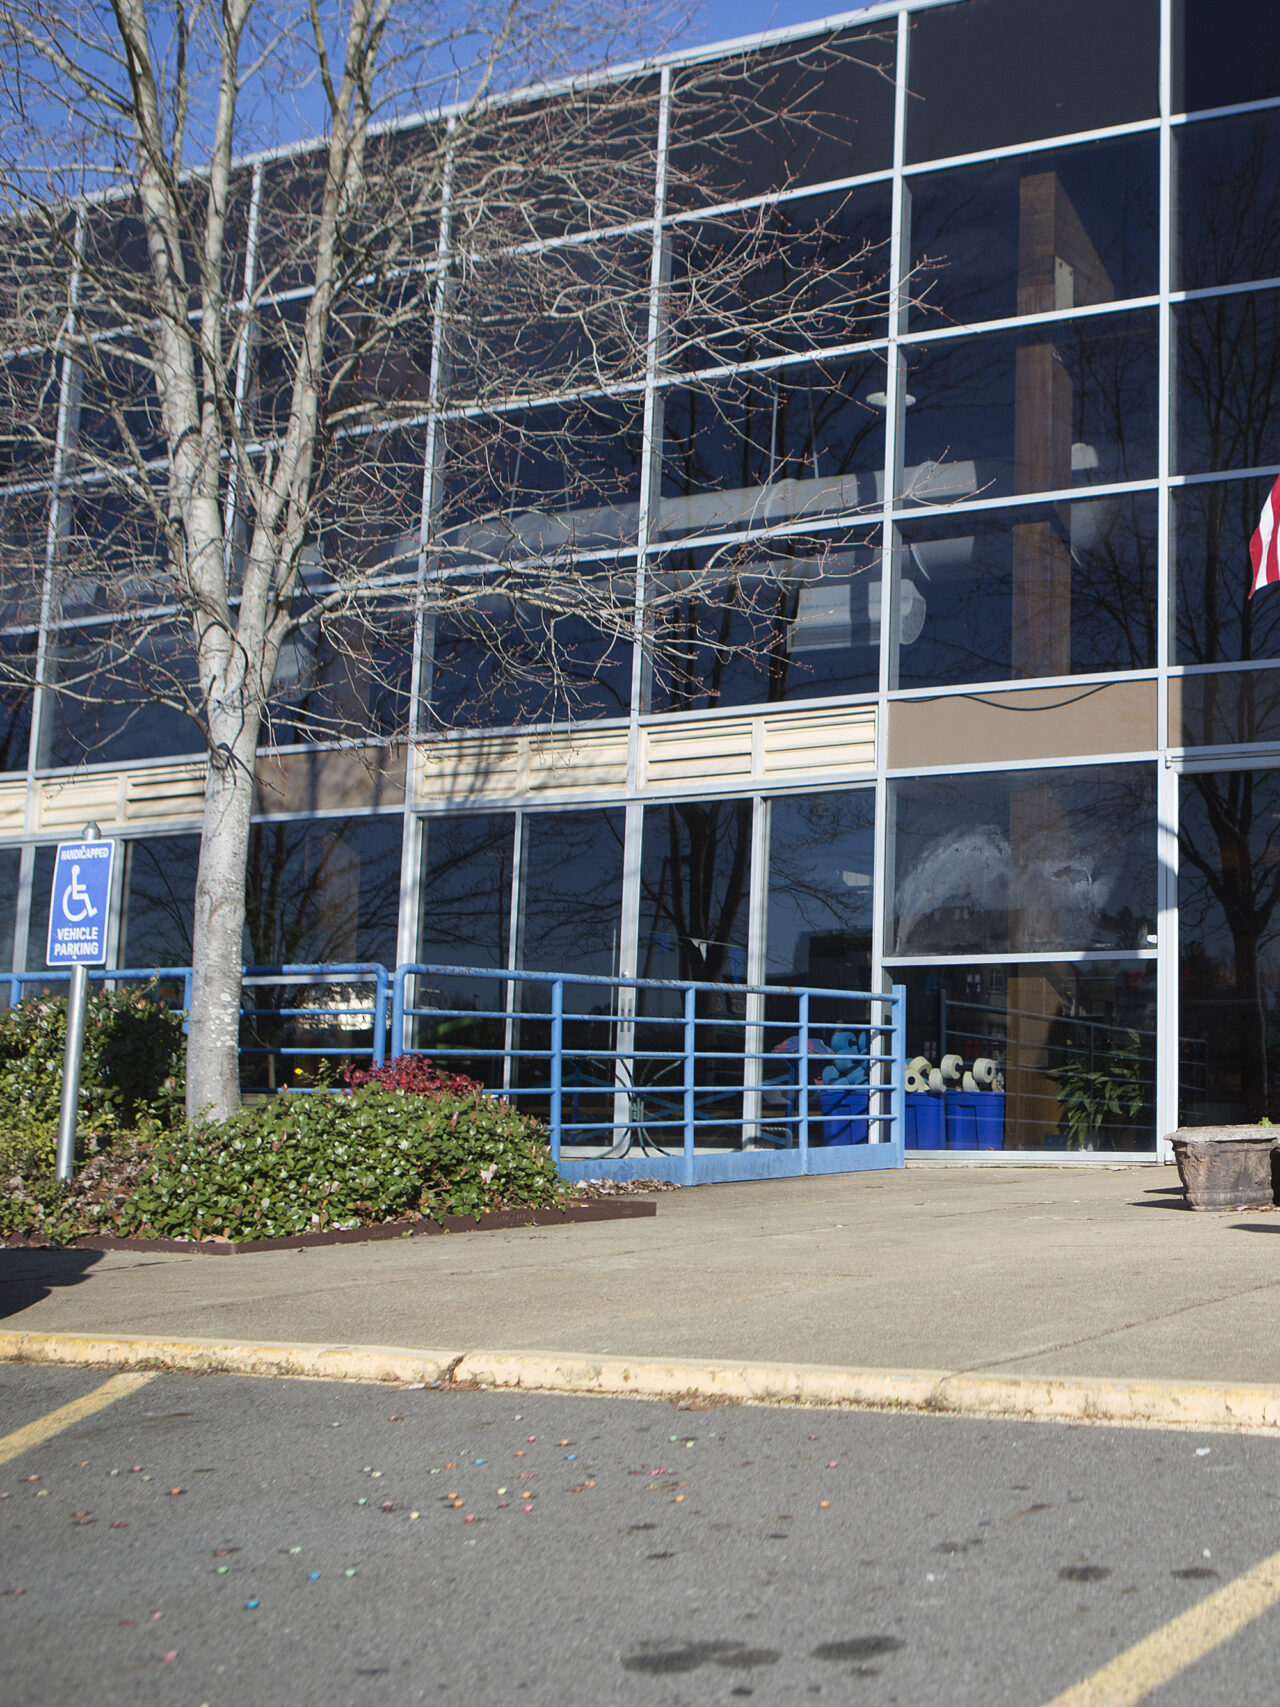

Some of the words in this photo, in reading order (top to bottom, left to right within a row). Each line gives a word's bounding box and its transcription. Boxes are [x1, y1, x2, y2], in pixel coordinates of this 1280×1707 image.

[60, 847, 109, 860] HANDICAPPED
[57, 927, 99, 941] VEHICLE
[54, 942, 99, 956] PARKING
